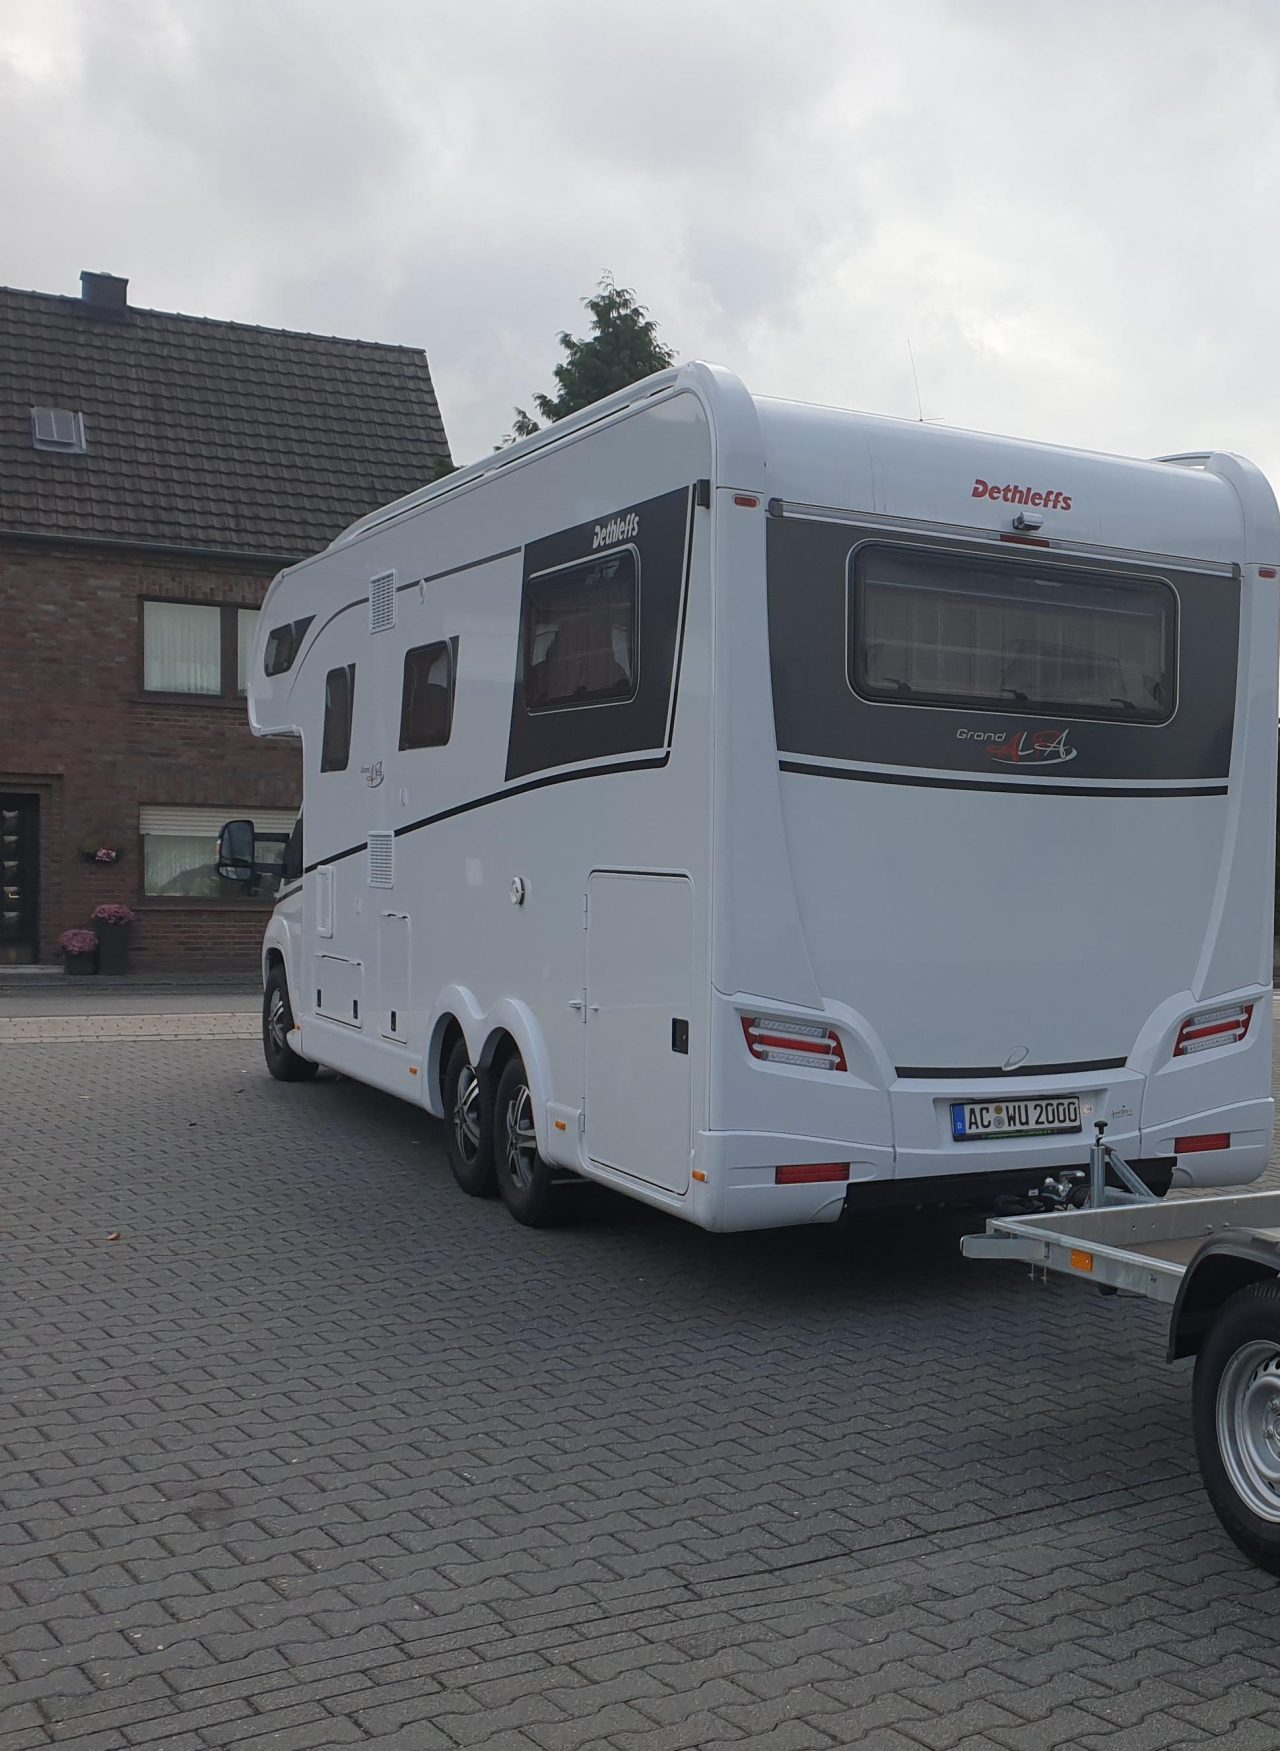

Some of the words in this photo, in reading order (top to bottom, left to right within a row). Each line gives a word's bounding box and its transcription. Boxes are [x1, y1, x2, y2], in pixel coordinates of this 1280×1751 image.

[972, 479, 1072, 511] Dethleffs
[593, 513, 639, 549] Dethleffs
[956, 729, 1006, 742] Grand
[968, 1106, 991, 1130] AC
[1005, 1103, 1030, 1127] WU
[1034, 1101, 1078, 1125] 2000
